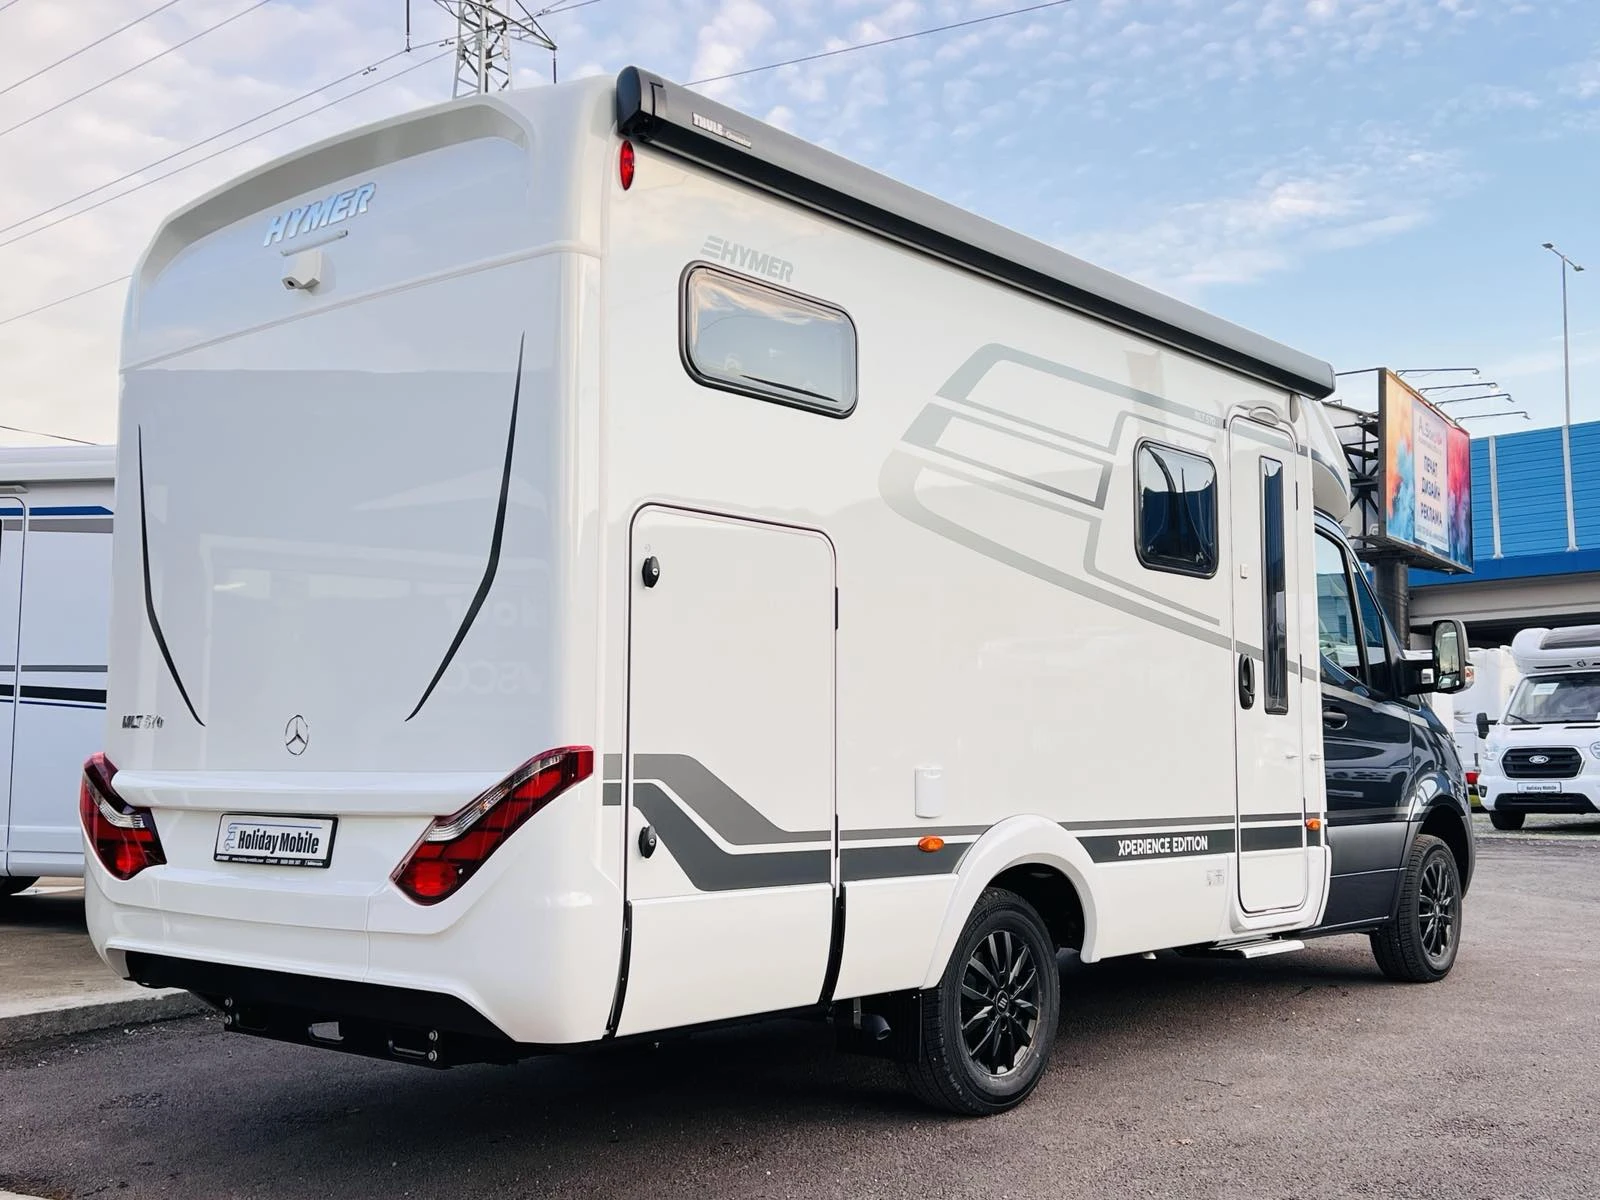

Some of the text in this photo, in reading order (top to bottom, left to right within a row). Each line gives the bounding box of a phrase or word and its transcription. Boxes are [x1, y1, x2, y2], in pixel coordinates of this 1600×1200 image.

[693, 112, 724, 136] THULE
[263, 182, 376, 247] HYMER
[720, 239, 794, 283] HYMER
[1422, 477, 1440, 501] ДИЗАЙН
[1420, 502, 1443, 527] РЕКЛАМА
[237, 828, 320, 855] Holiday Mobile
[1117, 835, 1209, 857] XPERIENCE EDITION
